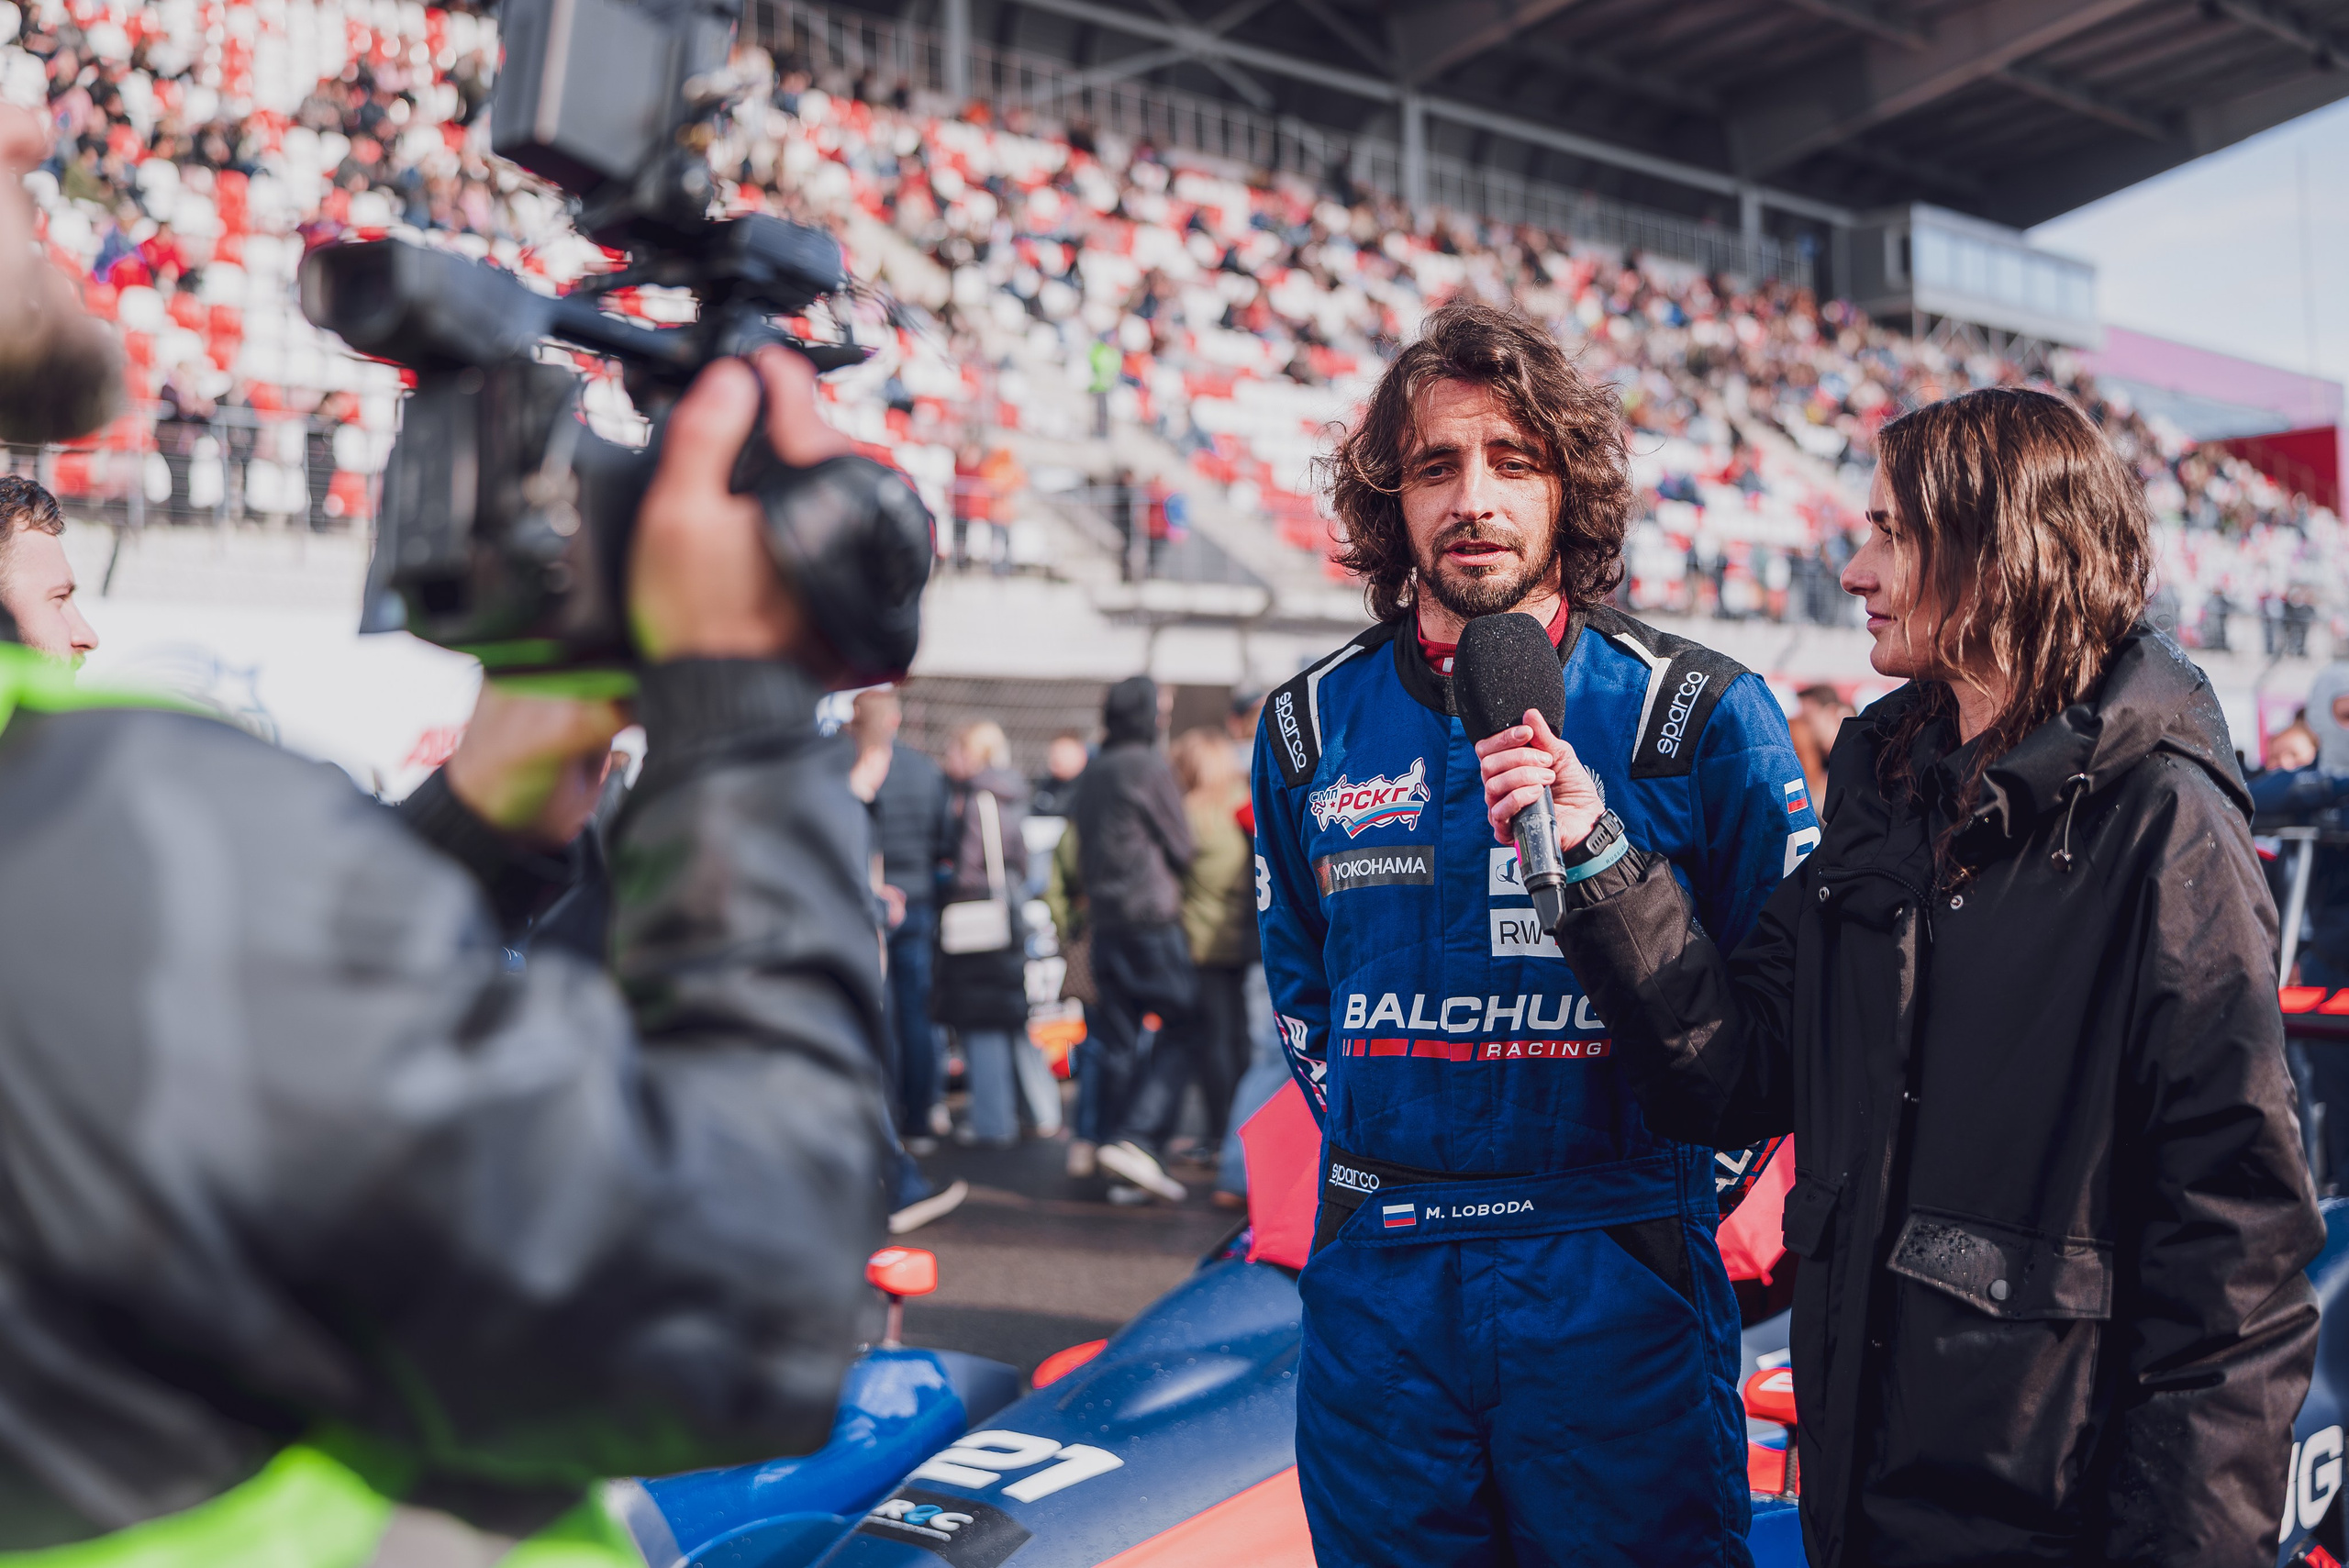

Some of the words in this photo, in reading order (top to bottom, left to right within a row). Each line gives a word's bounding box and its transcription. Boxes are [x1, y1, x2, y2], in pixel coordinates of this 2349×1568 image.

[1656, 671, 1709, 758] sparco
[1275, 691, 1307, 773] sparco
[1337, 787, 1408, 814] РСКГ
[1331, 857, 1427, 881] YOKOHAMA
[1486, 1042, 1602, 1057] RACING
[1330, 1162, 1380, 1193] sparco
[1426, 1207, 1445, 1219] M.
[1452, 1199, 1534, 1218] LOBODA
